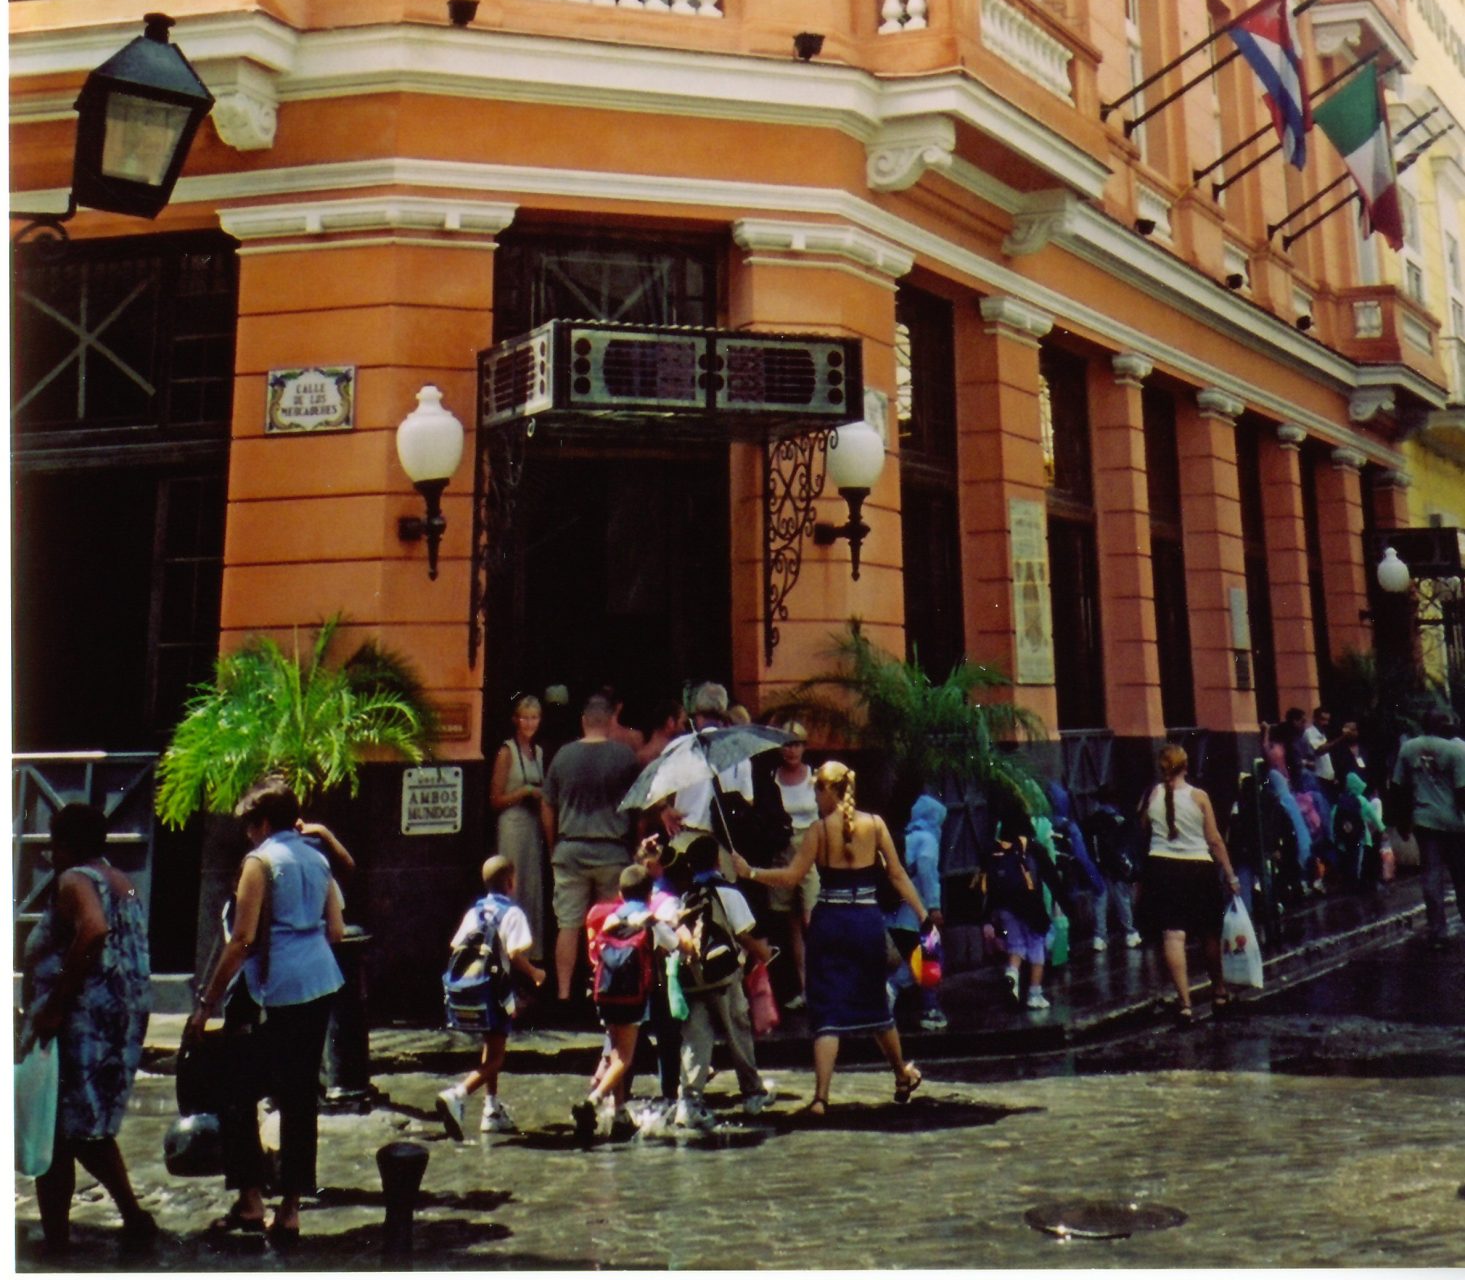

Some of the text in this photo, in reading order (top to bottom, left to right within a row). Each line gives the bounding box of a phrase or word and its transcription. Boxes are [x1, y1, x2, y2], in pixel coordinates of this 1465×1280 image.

[296, 383, 325, 394] CALLE
[409, 790, 458, 805] AMBOS
[408, 805, 458, 820] MUNDOS
